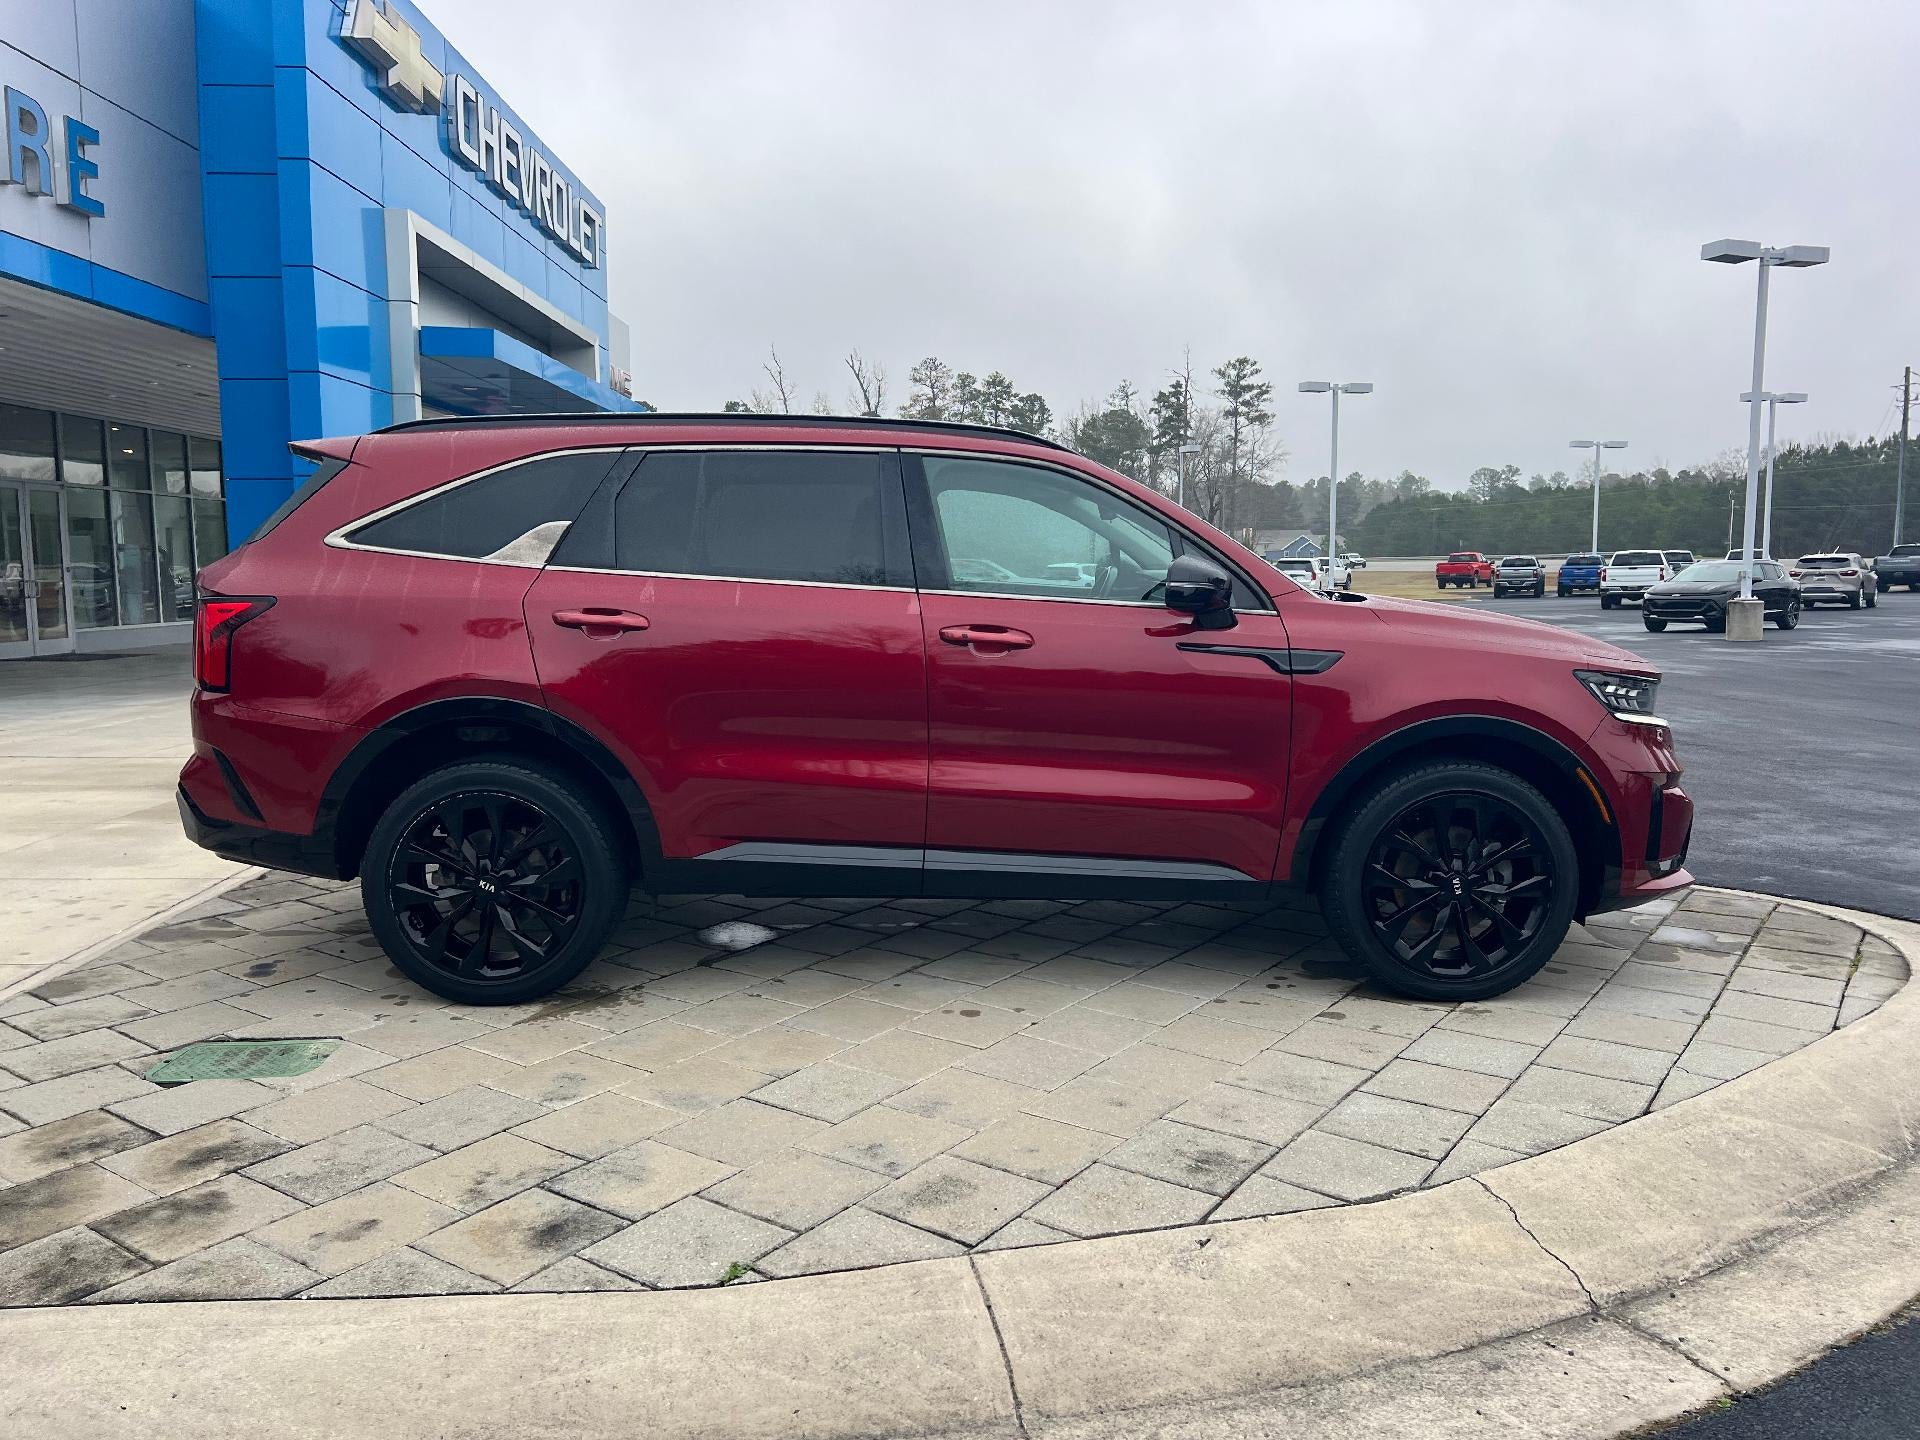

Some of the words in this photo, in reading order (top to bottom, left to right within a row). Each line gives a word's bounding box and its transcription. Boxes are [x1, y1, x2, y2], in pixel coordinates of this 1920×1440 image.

[451, 73, 602, 271] CHEVROLET
[478, 879, 496, 893] KIA
[1452, 877, 1462, 895] KIA
